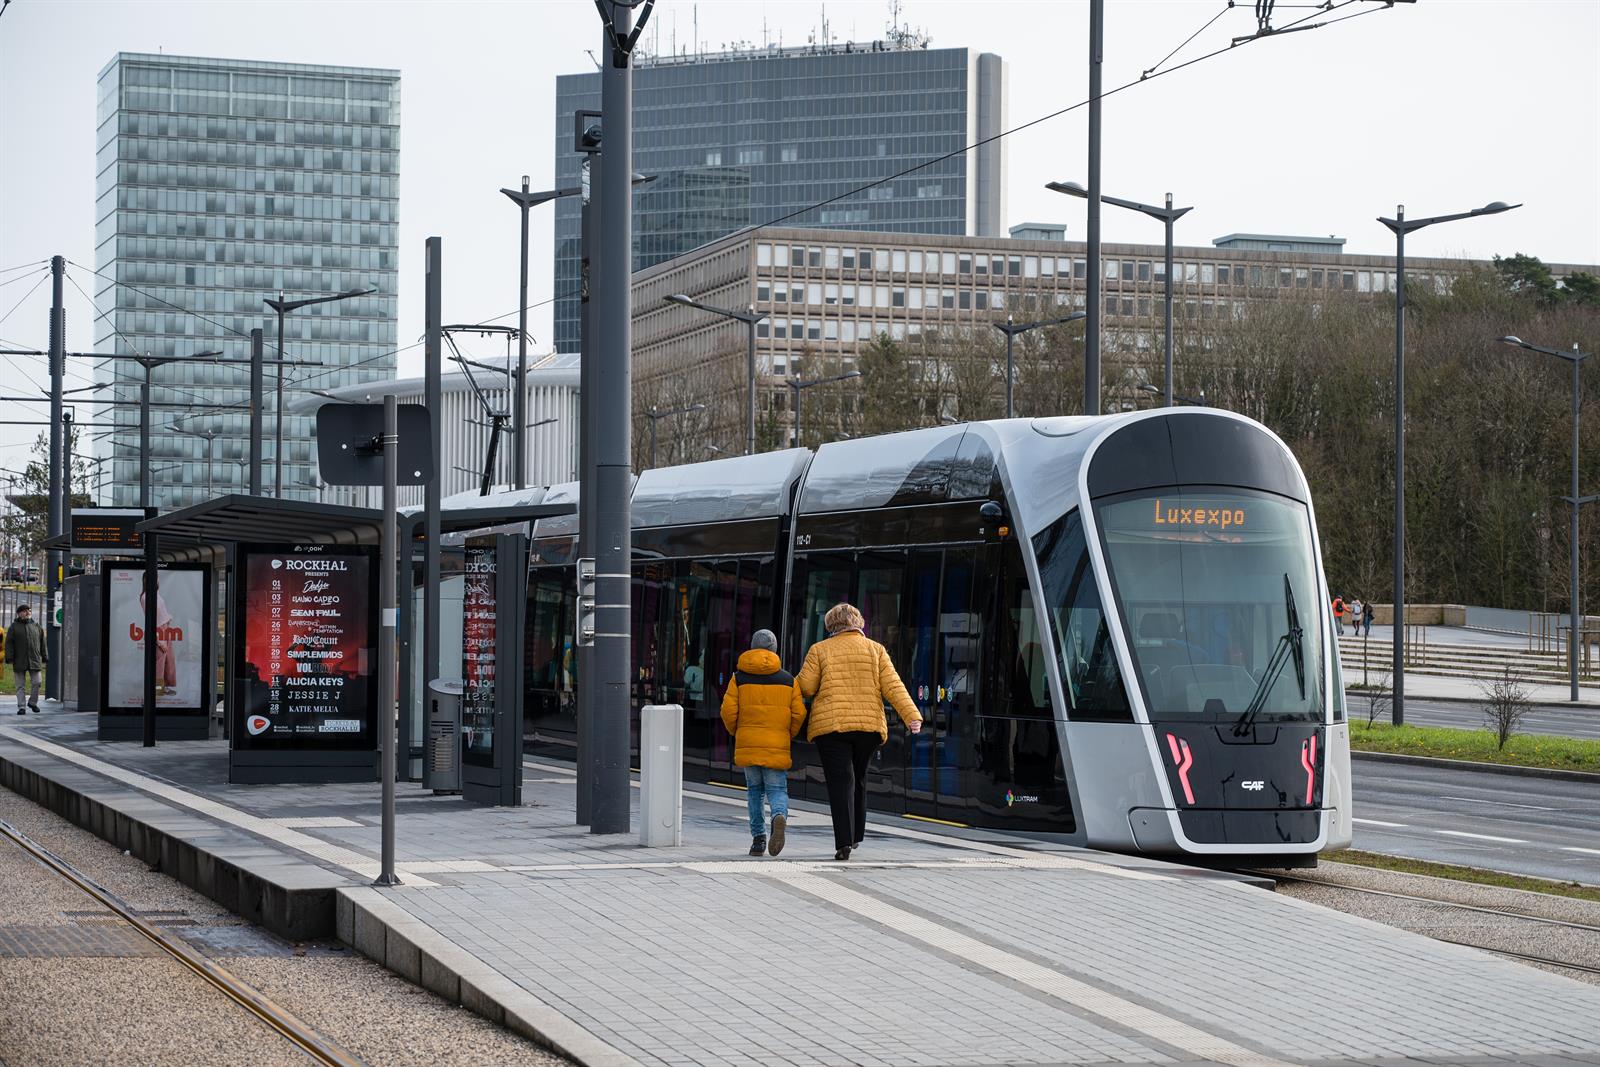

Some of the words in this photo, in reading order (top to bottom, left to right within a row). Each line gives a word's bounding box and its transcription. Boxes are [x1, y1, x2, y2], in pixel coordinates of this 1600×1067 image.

[1155, 500, 1245, 529] Luxexpo
[286, 560, 347, 570] ROCKHAL
[288, 691, 328, 700] JESSIE
[335, 691, 340, 700] J
[1242, 781, 1264, 790] CAF
